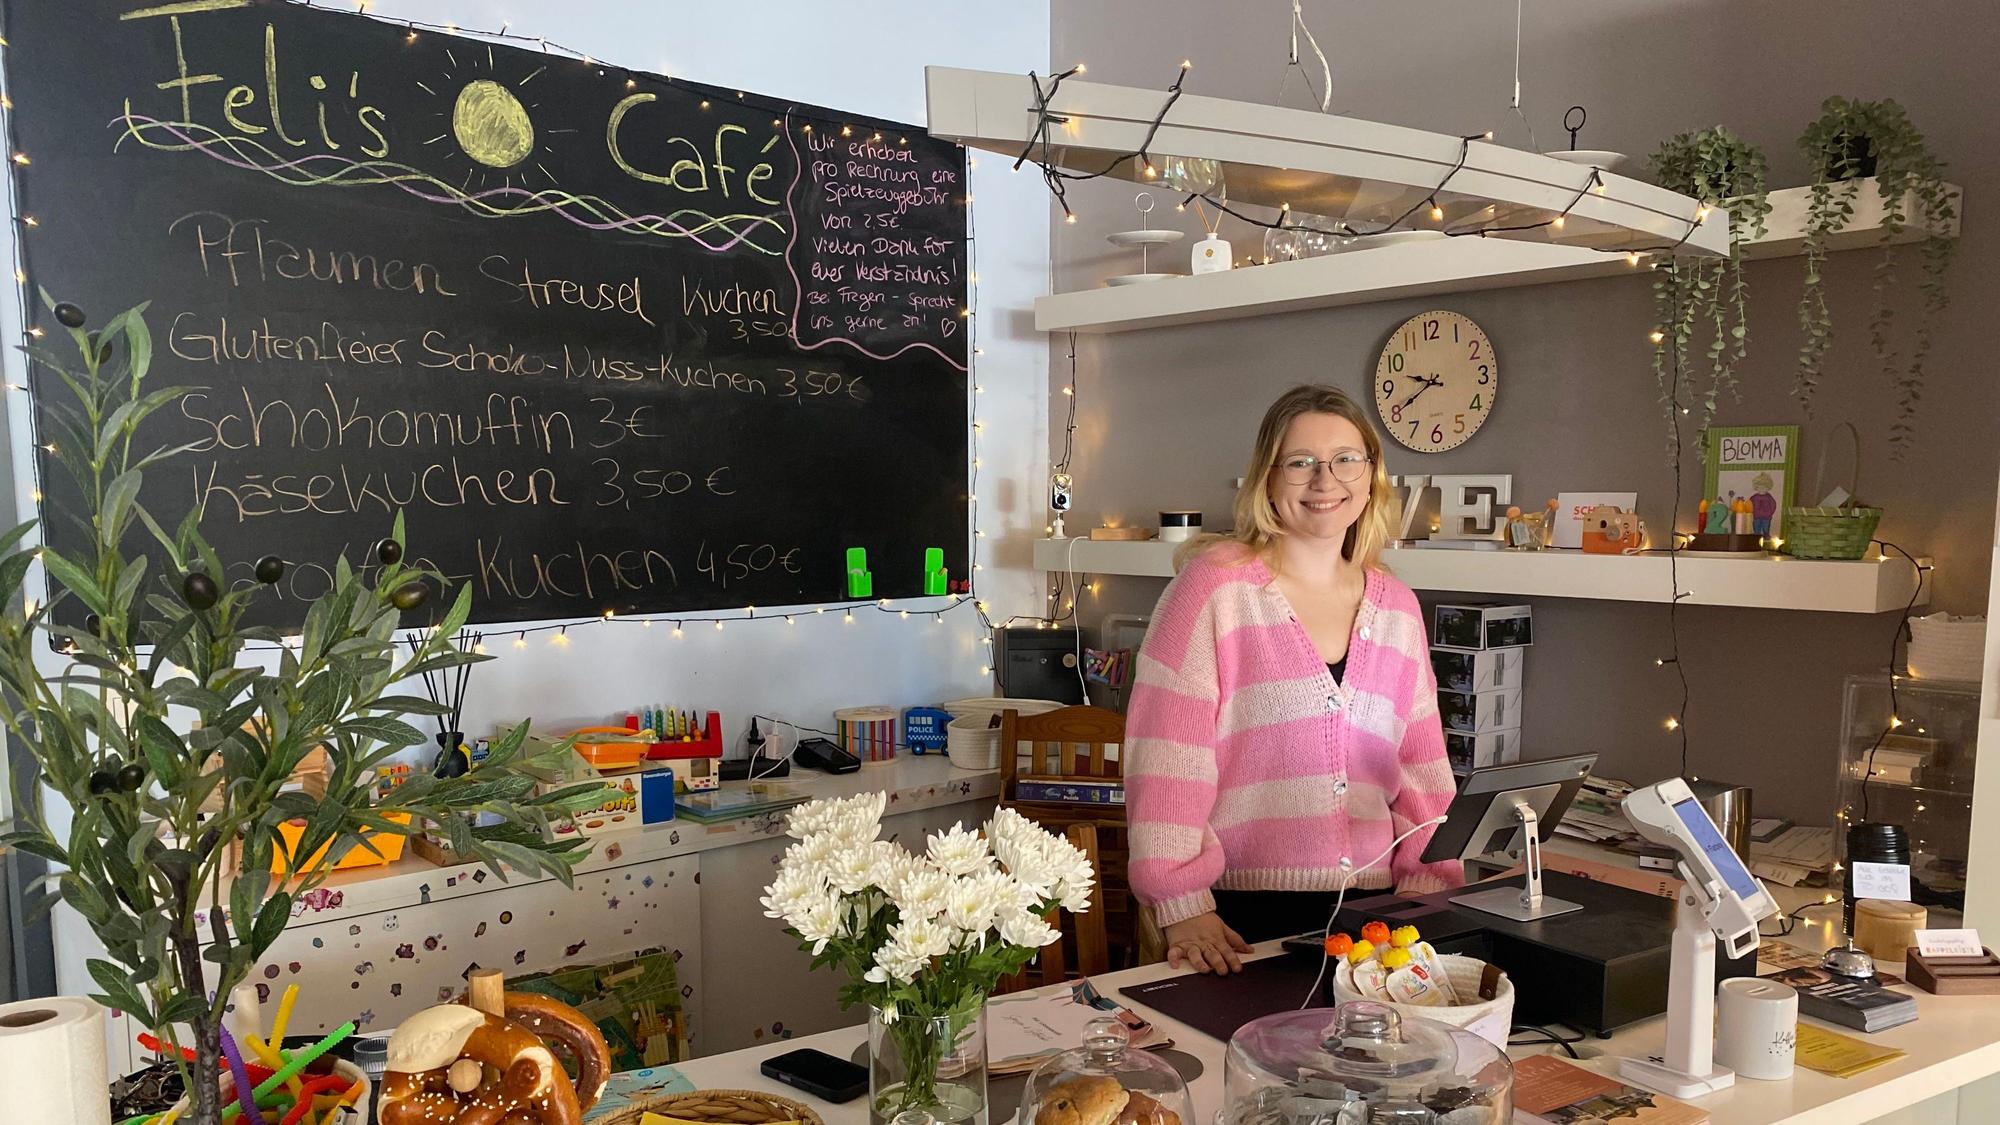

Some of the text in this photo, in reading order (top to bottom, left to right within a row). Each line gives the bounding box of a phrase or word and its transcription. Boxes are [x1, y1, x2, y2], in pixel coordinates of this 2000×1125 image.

[118, 0, 781, 205] Feli's Café
[808, 133, 918, 163] Wir erheben
[847, 161, 921, 192] Rechnung
[932, 170, 956, 183] eine
[813, 236, 865, 257] Vielen
[871, 237, 919, 257] Dank
[169, 211, 457, 297] Pflaumen
[479, 255, 656, 327] Streusel
[807, 291, 830, 305] Bei
[837, 286, 886, 312] Fragen
[845, 315, 888, 333] gerne
[1423, 320, 1440, 341] 12
[1404, 331, 1416, 351] 11
[1468, 340, 1480, 360] 2
[169, 311, 406, 377] Glutenfreier
[775, 368, 866, 405] 3,50€
[1388, 353, 1404, 373] 10
[1477, 365, 1489, 385] 3
[1382, 380, 1394, 399] 9
[1469, 393, 1482, 411] 4
[181, 383, 665, 454] Schokomuffin 3€
[1391, 404, 1402, 423] 8
[1408, 420, 1419, 439] 7
[1431, 424, 1443, 444] 6
[1453, 414, 1465, 434] 5
[1723, 437, 1783, 462] BLOMMA
[696, 540, 802, 589] 4,50€
